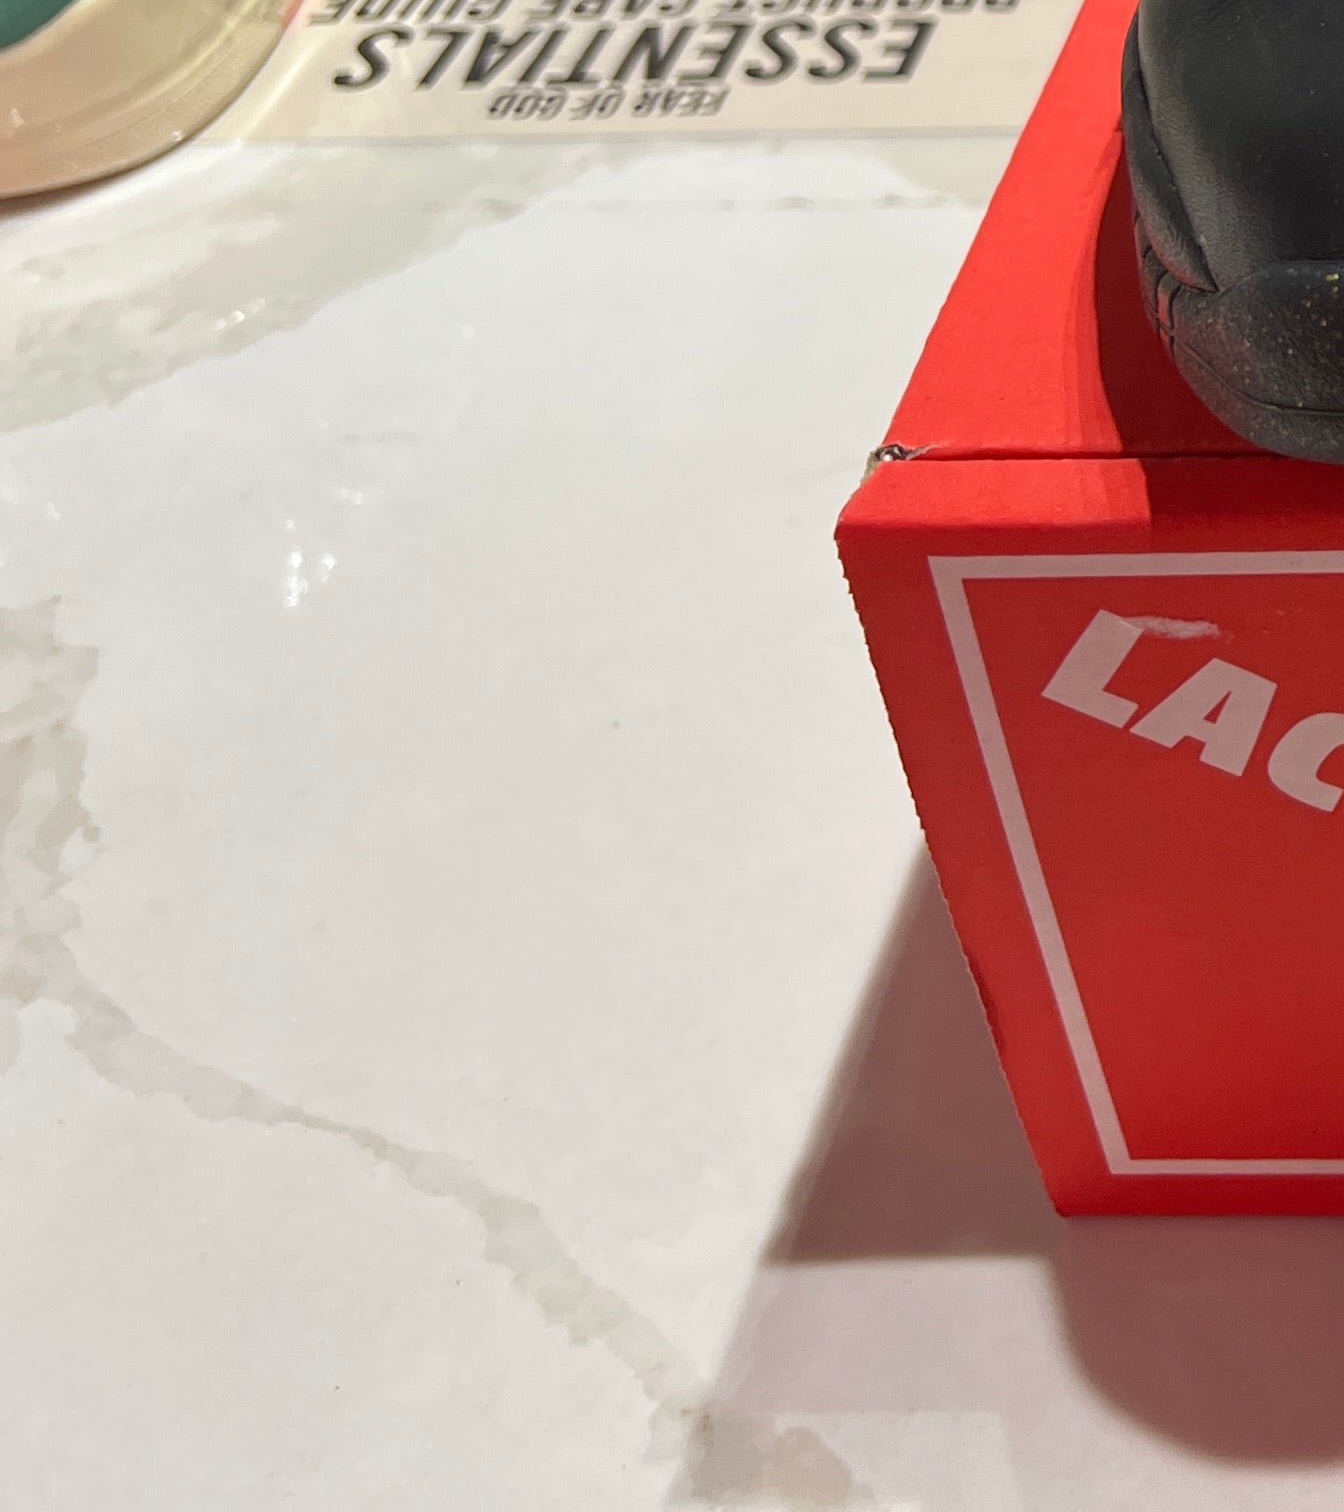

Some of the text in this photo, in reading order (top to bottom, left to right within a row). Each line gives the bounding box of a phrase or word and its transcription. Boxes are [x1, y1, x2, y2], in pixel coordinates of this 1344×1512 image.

[332, 18, 940, 93] ESSENTIALS
[485, 90, 728, 122] FEAR OF GOD
